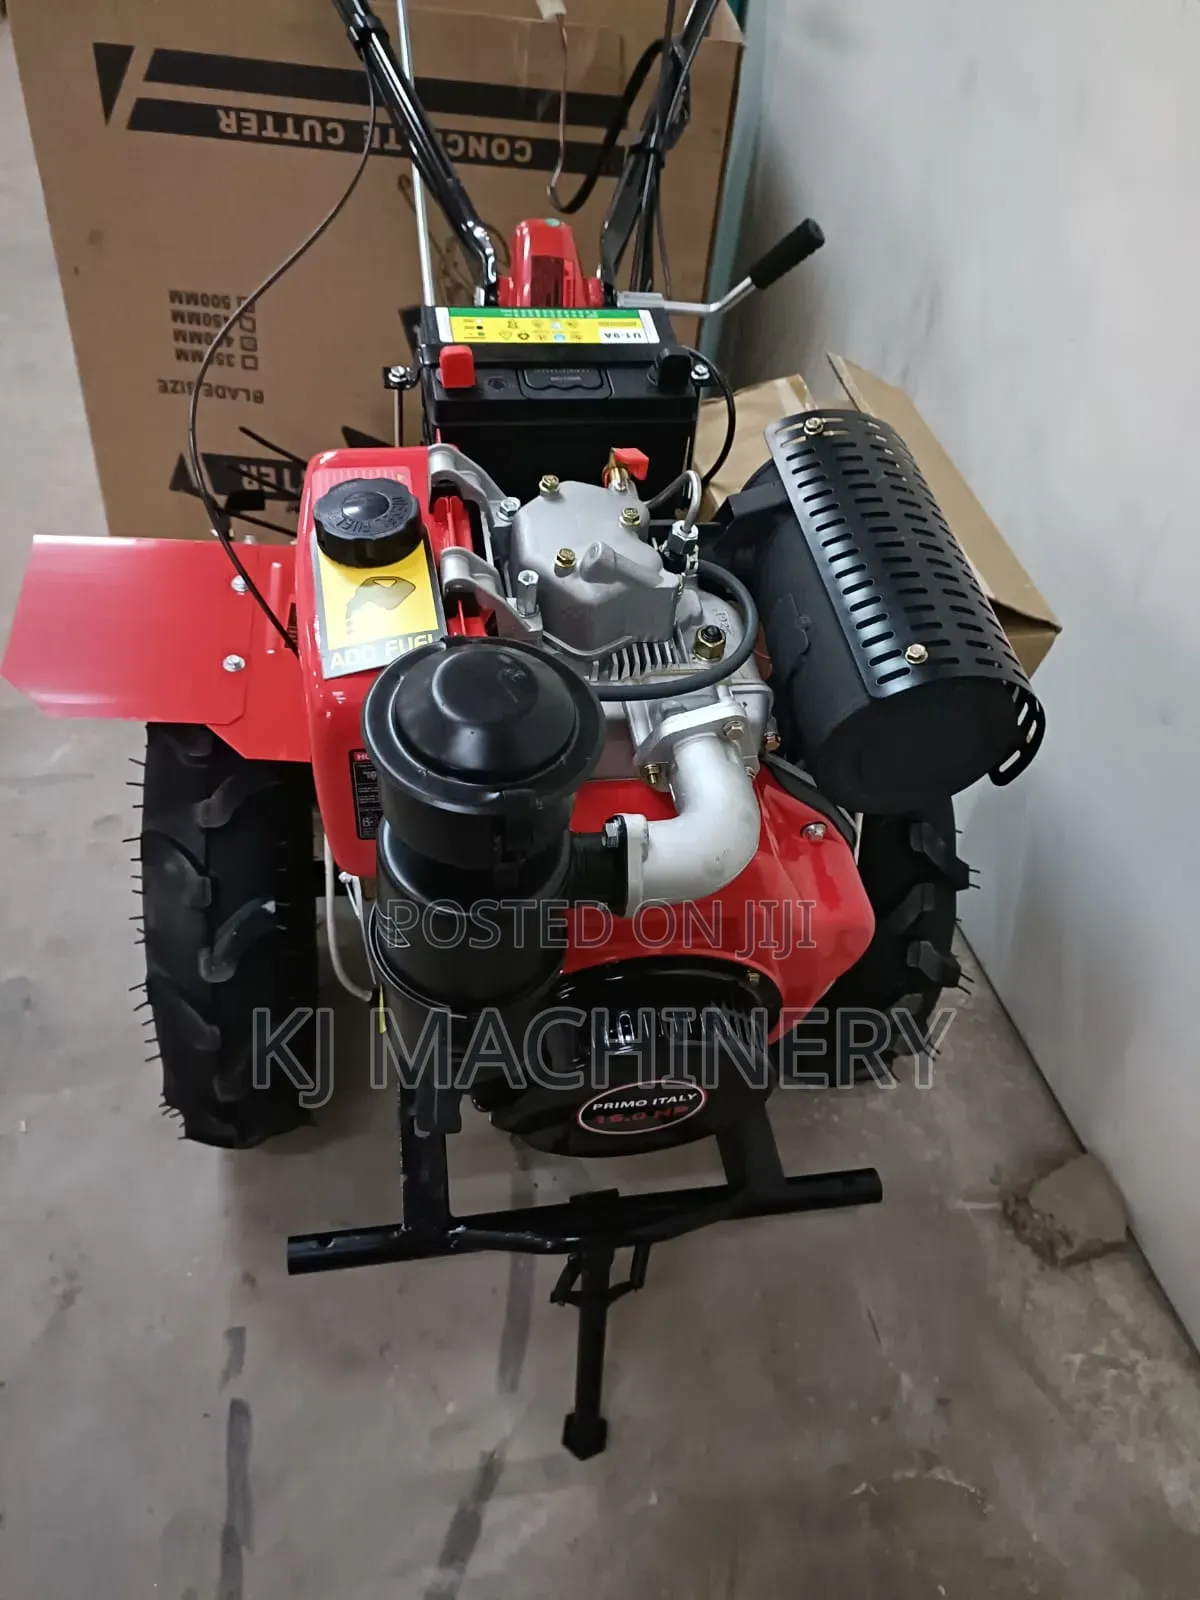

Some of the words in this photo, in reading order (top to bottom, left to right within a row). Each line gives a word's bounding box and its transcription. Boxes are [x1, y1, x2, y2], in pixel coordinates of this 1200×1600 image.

[216, 108, 345, 145] CUTTER
[362, 124, 533, 163] CONCTE
[168, 289, 231, 310] 500MM
[173, 328, 235, 348] 40MM
[175, 347, 236, 368] 35MM
[202, 382, 264, 404] BLADE
[330, 644, 377, 671] ADD
[593, 1099, 647, 1110] PRIMO
[652, 1093, 698, 1106] ITALY
